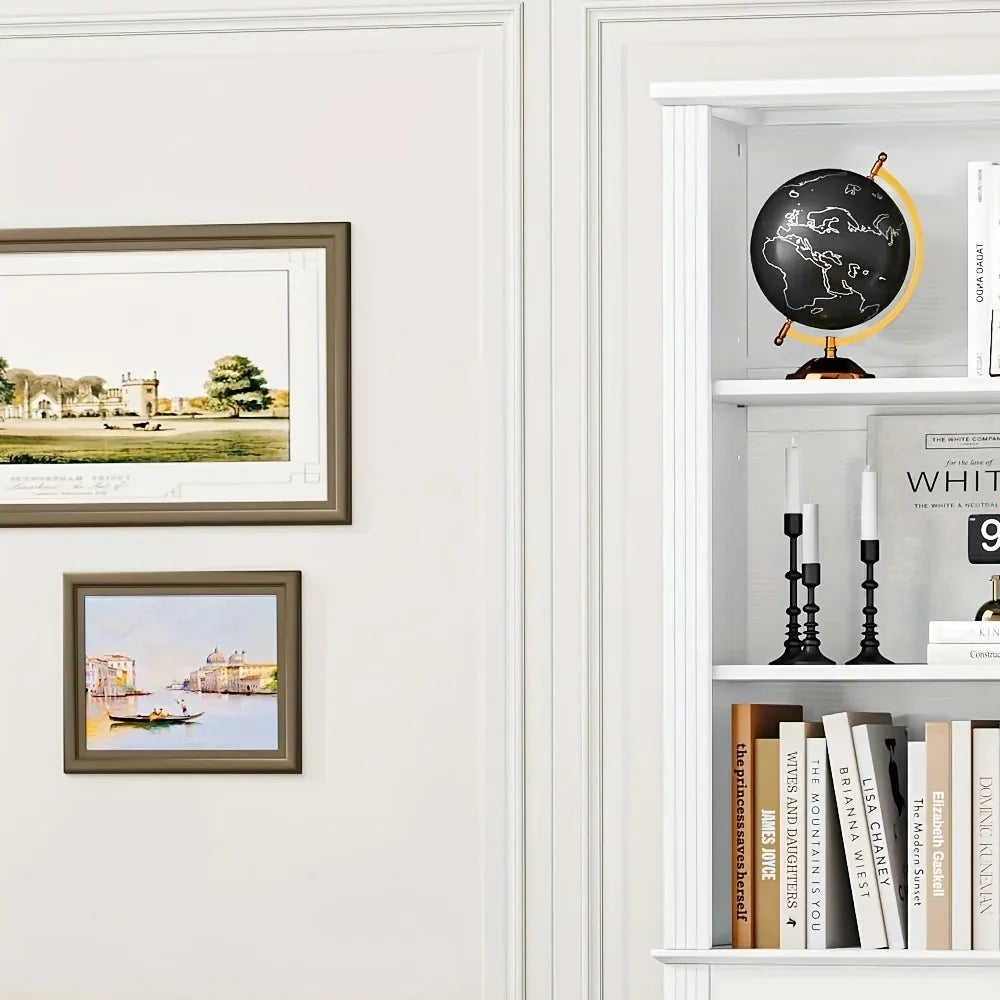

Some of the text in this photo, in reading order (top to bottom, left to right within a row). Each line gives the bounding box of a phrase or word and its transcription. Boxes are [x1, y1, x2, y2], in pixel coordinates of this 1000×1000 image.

[734, 744, 747, 921] the princess saves herself
[762, 809, 776, 881] JAMES JOYCE
[786, 752, 797, 909] WIVES AND DAUGHTERS
[812, 793, 820, 874] MOUNTAIN
[840, 767, 870, 898] BRIANNA WIEST
[862, 778, 890, 886] LISA CHANEY
[914, 798, 924, 906] The Modern Sunset
[933, 792, 944, 896] Elizabeth Gaskell
[979, 777, 992, 837] DOMINIC
[812, 882, 820, 894] IS
[812, 901, 820, 931] YOU
